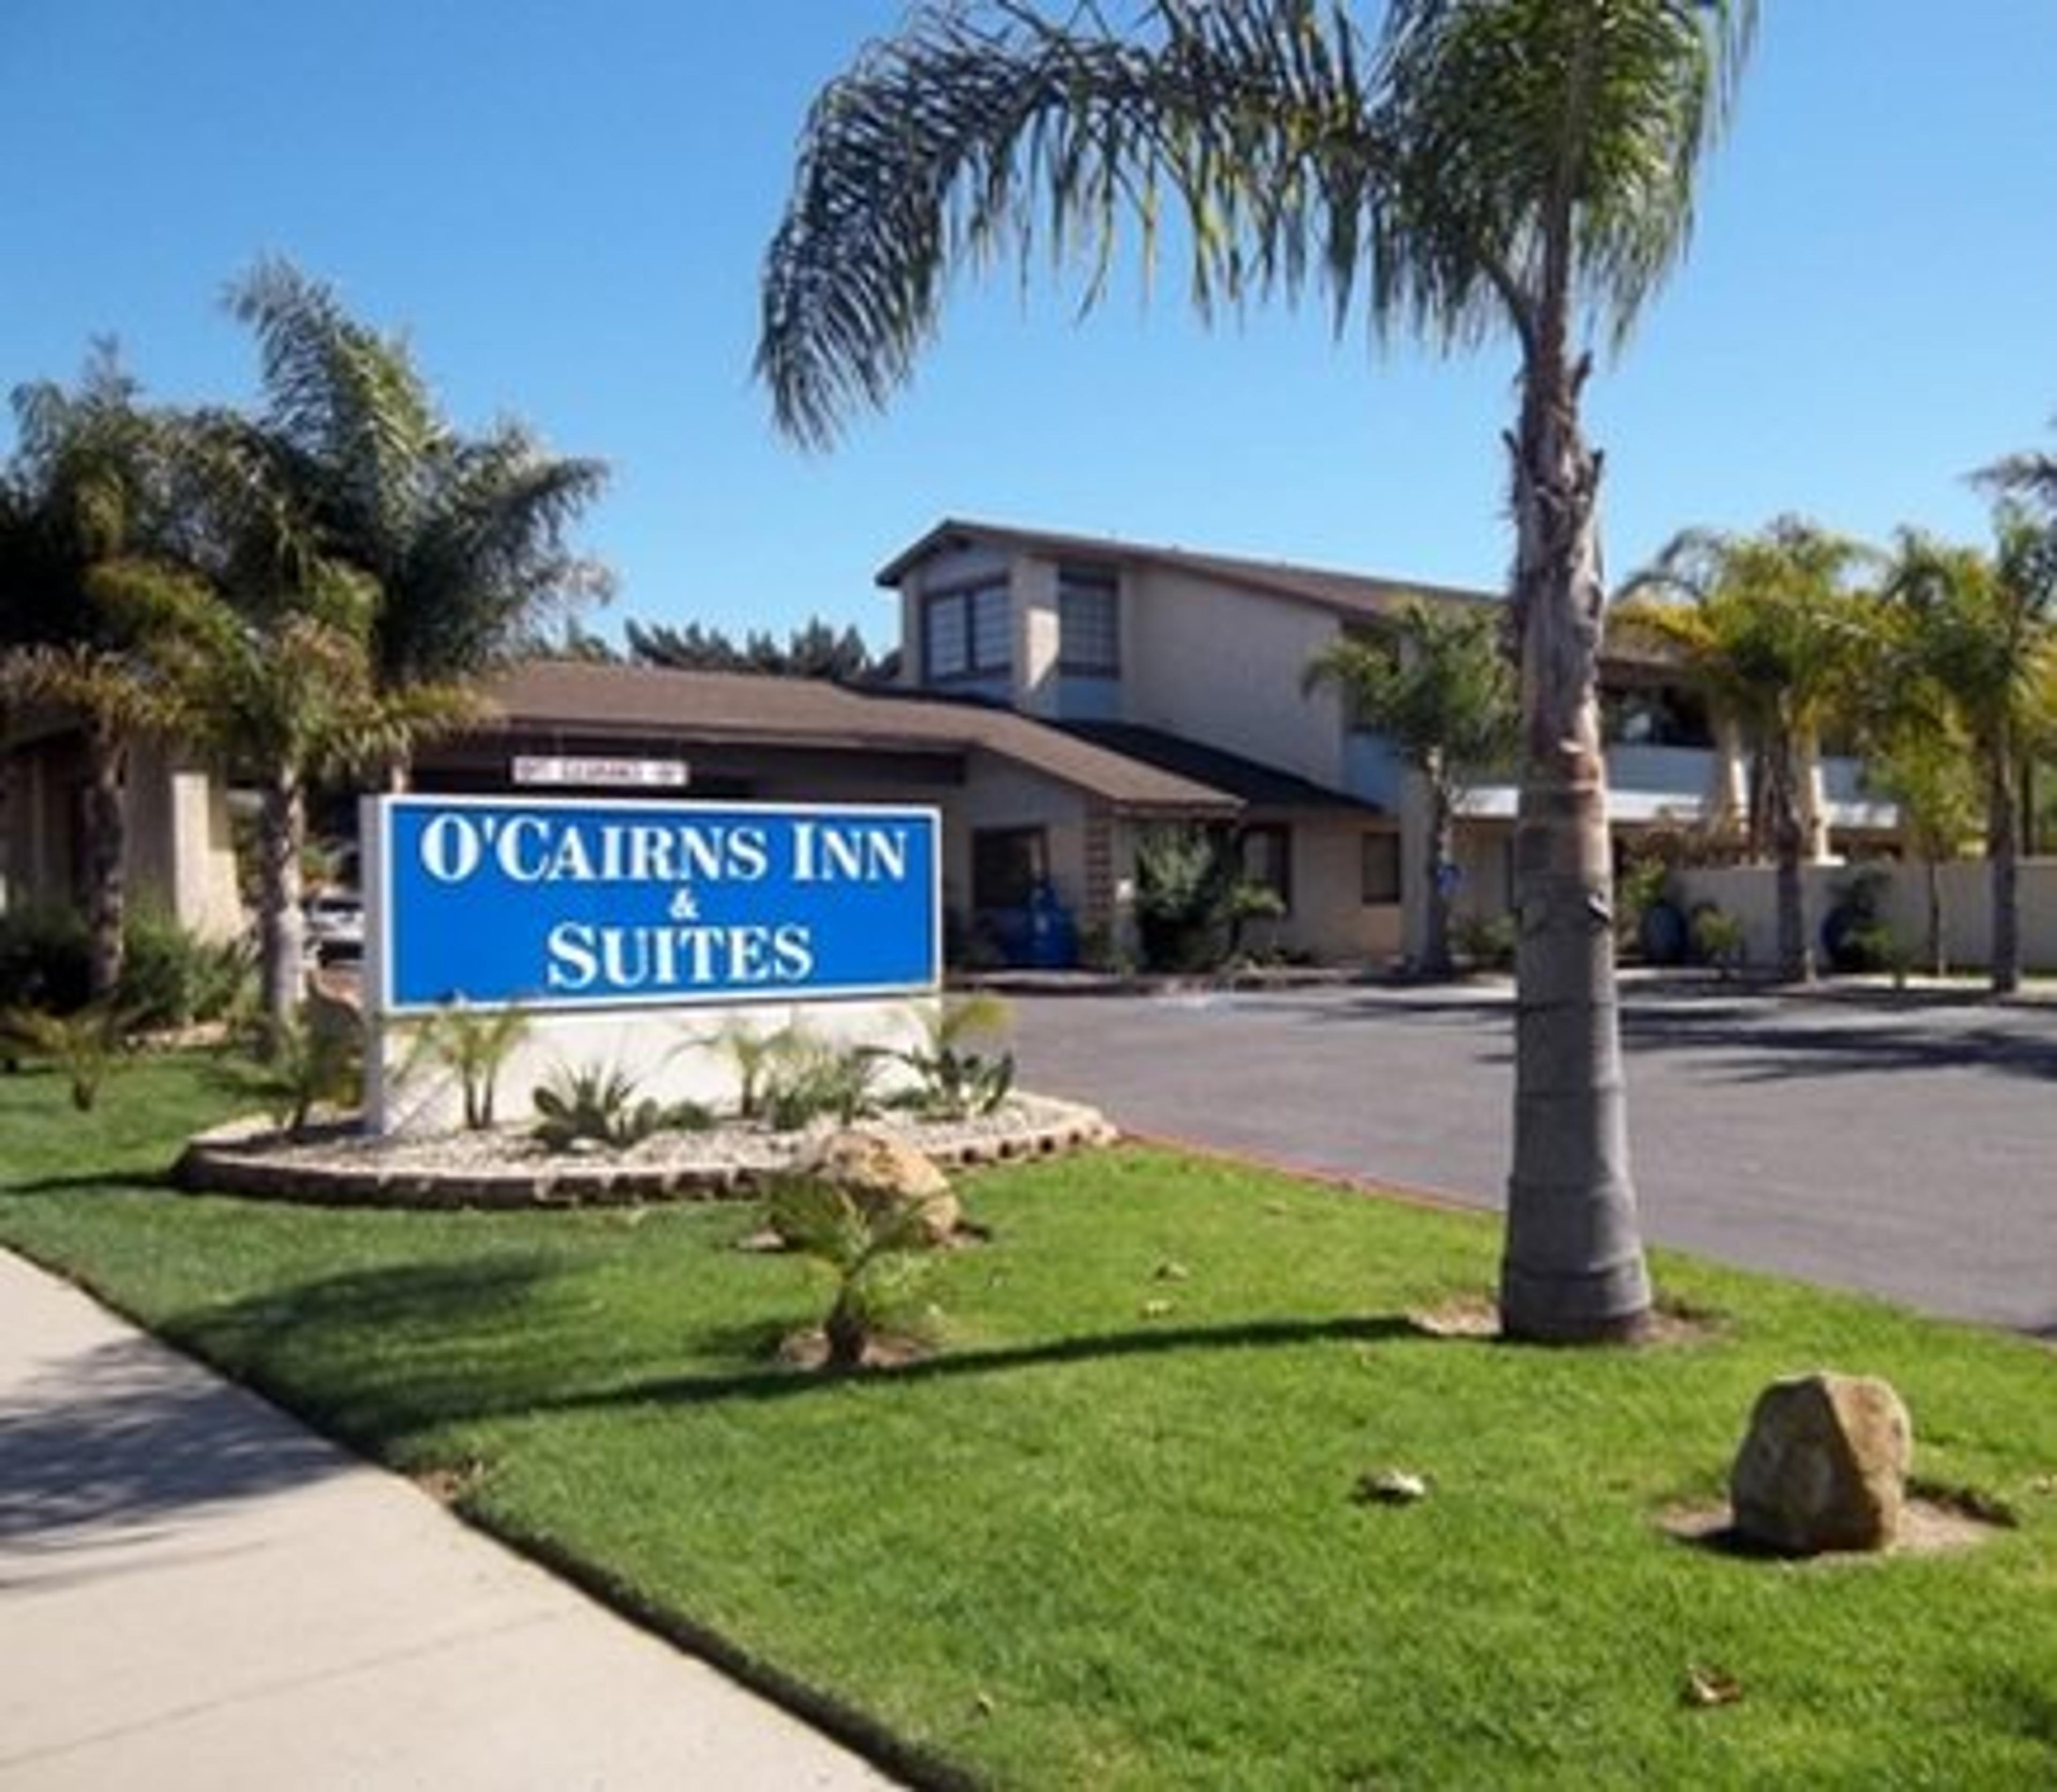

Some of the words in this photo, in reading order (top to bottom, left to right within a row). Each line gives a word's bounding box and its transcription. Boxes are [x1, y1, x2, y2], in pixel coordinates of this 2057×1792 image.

[421, 813, 768, 882] O'CAIRNS
[793, 821, 906, 881] INN
[669, 887, 699, 920] &
[547, 923, 813, 988] SUITES
